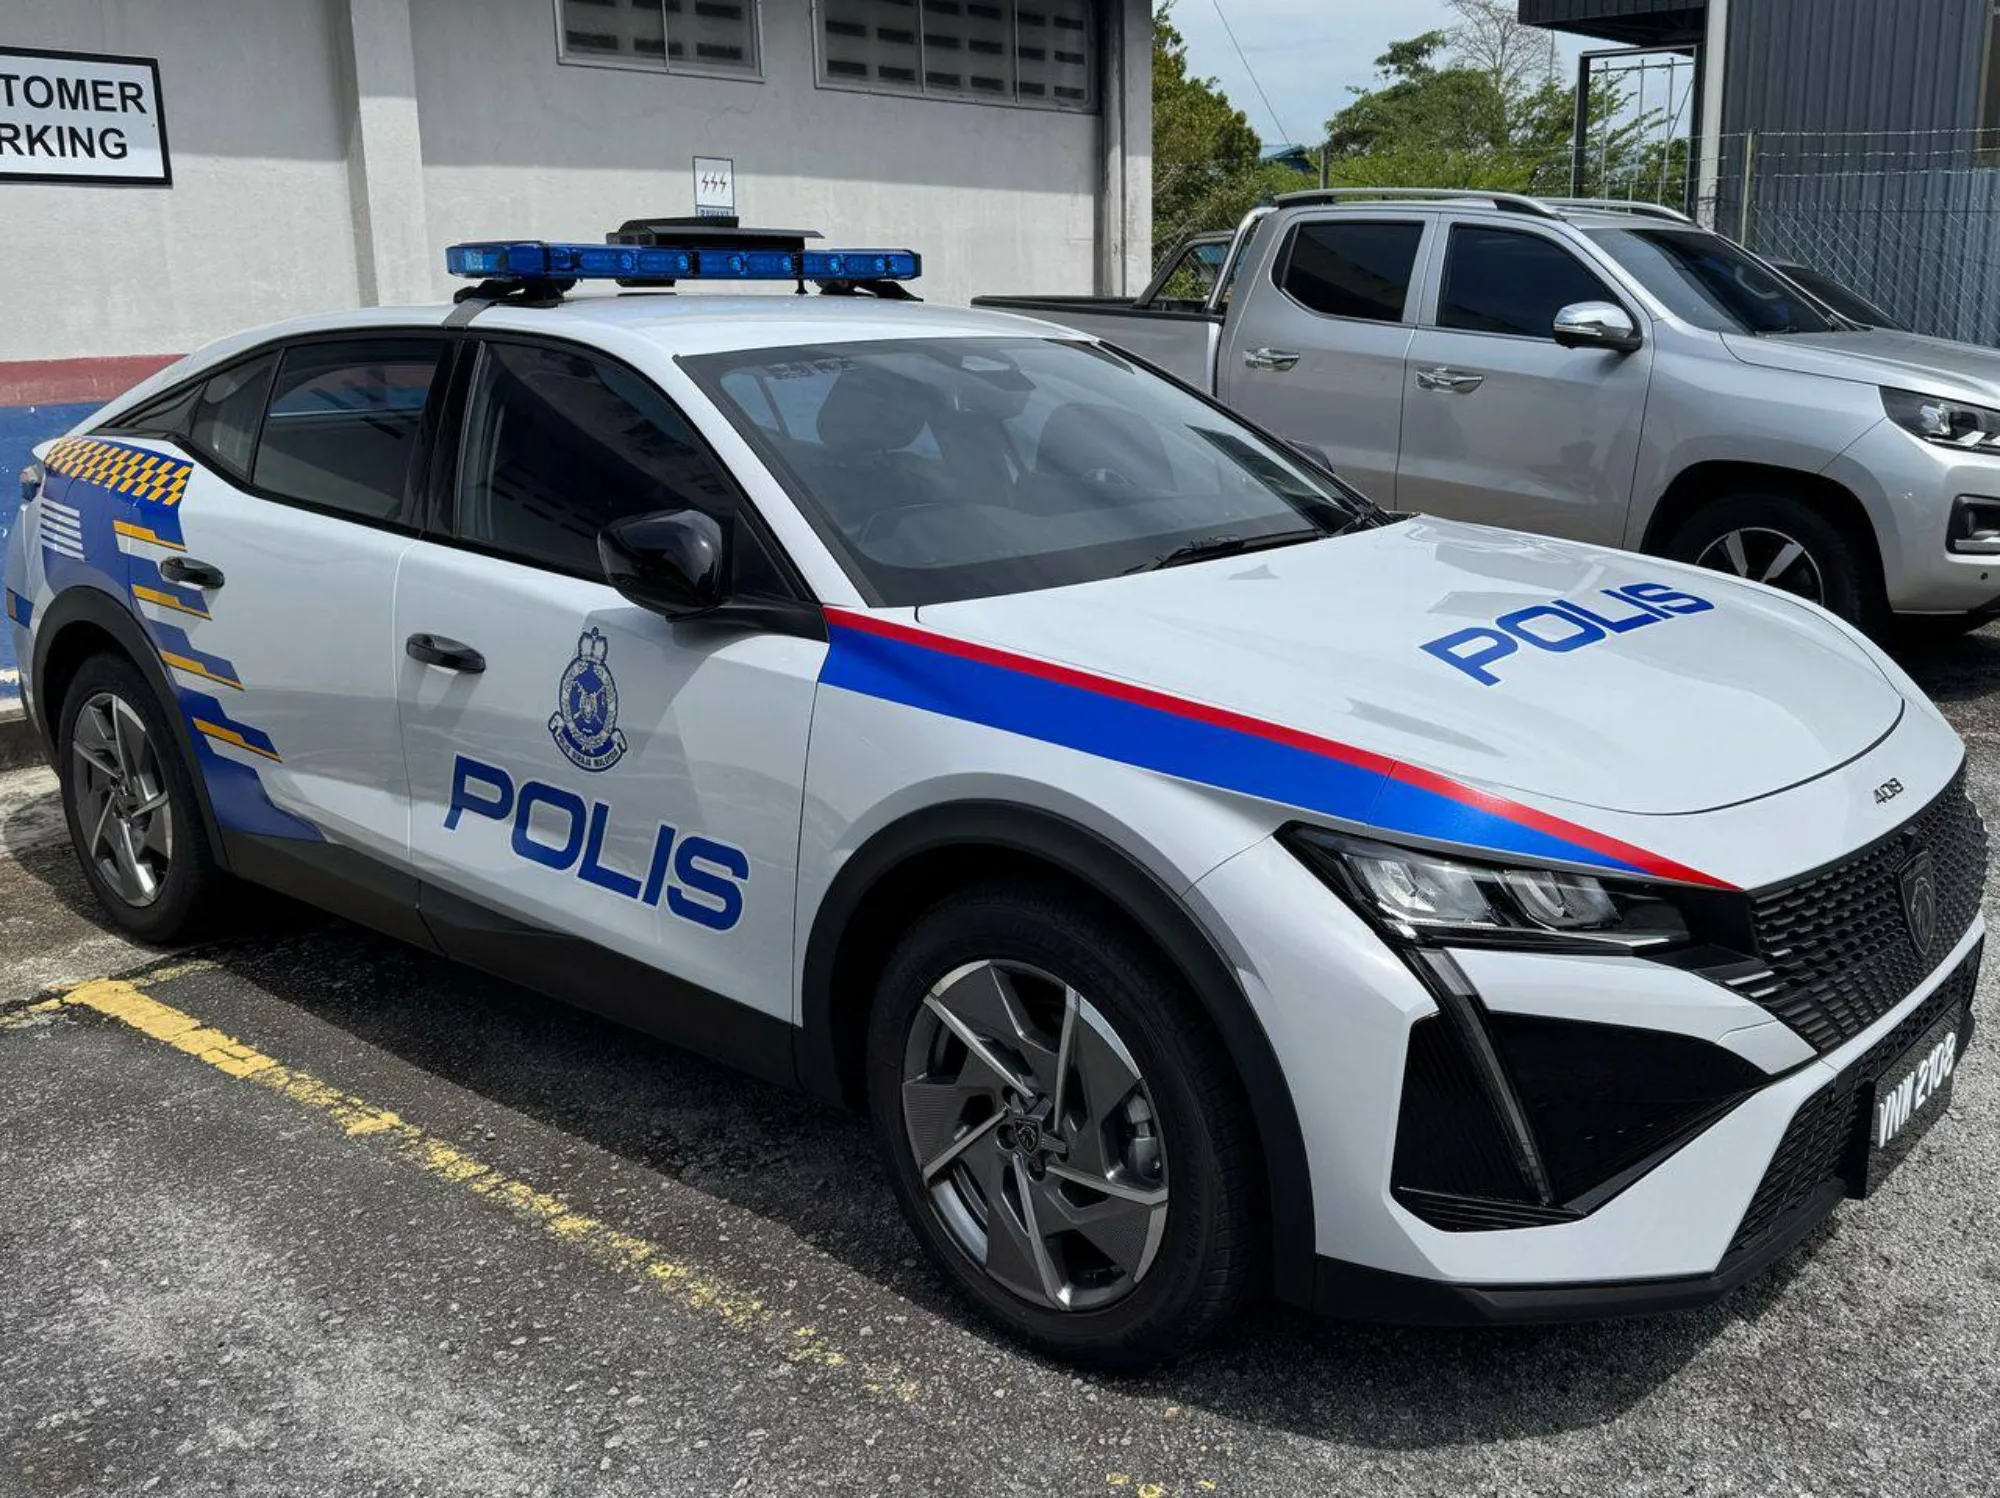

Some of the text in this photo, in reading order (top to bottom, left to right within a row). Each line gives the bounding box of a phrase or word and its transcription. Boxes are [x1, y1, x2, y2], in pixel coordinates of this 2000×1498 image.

[0, 74, 147, 114] TOMER
[0, 123, 128, 160] RKING
[1418, 583, 1715, 686] POLIS
[1874, 778, 1904, 804] 408
[444, 754, 749, 935] POLIS
[1915, 1032, 1956, 1109] 2108
